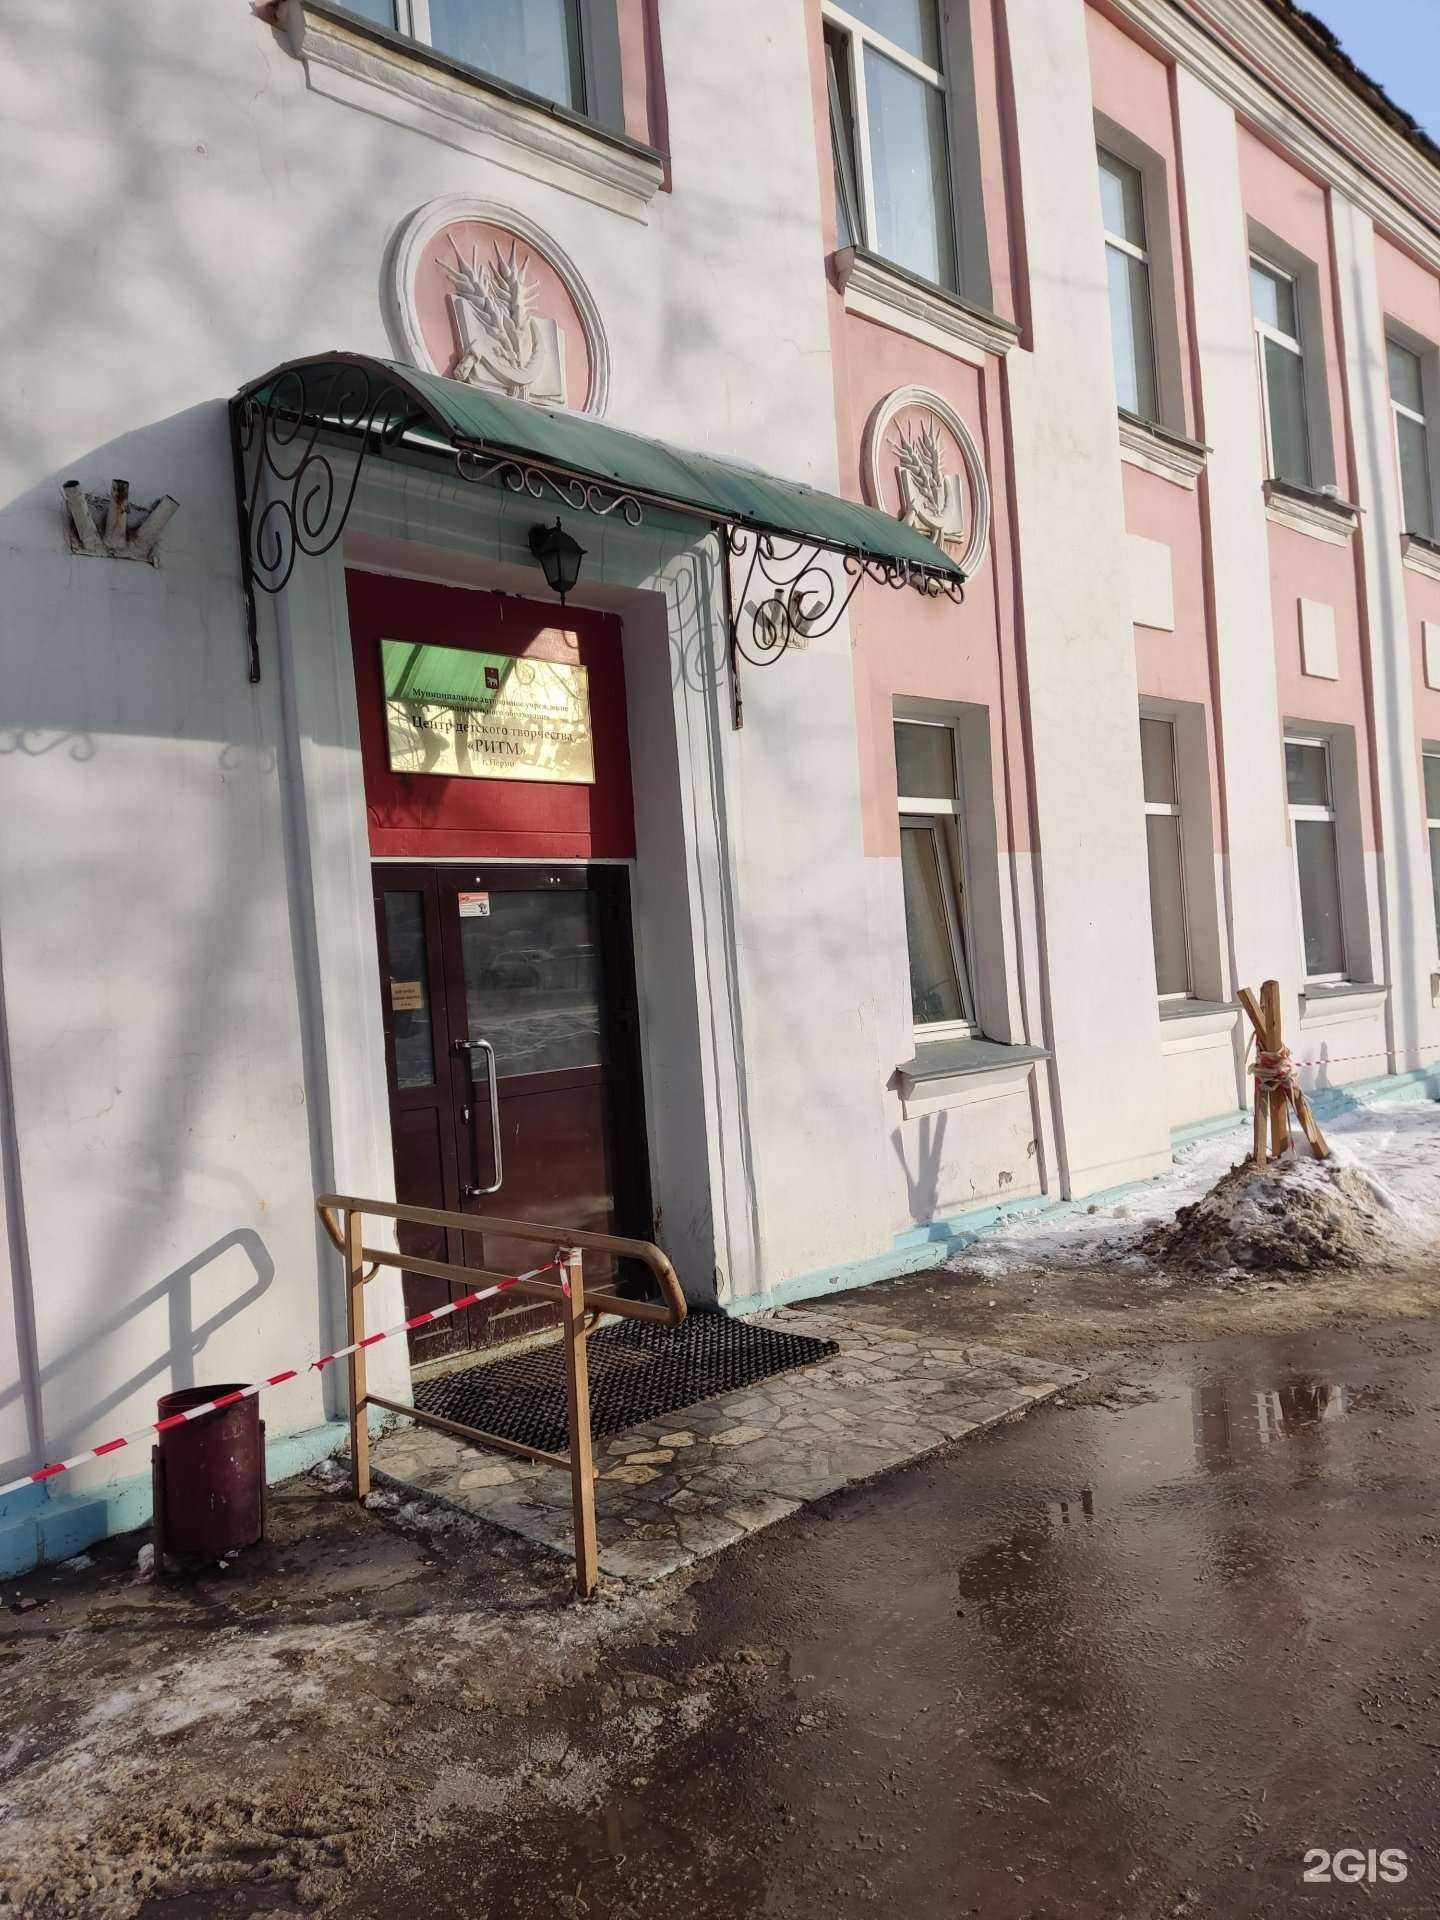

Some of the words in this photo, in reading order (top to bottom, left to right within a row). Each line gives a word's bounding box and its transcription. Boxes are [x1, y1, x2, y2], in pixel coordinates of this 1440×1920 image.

[412, 688, 479, 702] Муниципальное
[412, 716, 453, 734] Центр
[456, 723, 508, 736] детского
[511, 728, 573, 743] творчества
[467, 739, 526, 755] «РИТМ»
